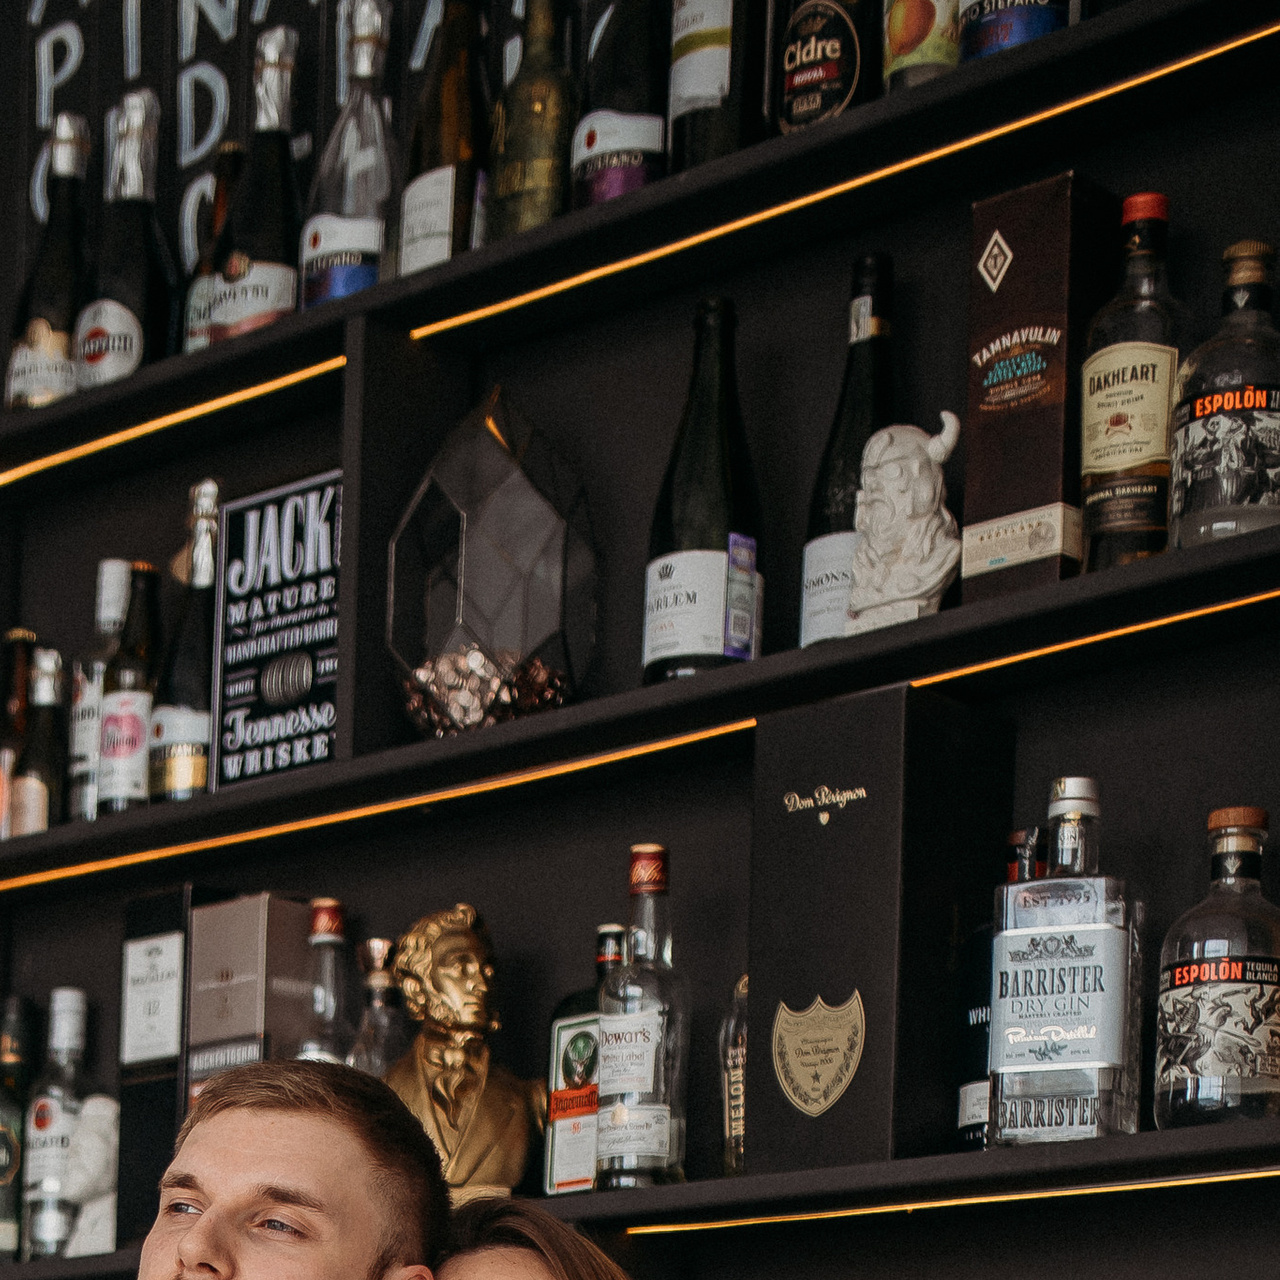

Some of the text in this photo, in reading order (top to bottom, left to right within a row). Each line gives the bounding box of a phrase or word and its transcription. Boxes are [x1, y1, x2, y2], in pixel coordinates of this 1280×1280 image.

[972, 326, 1062, 368] TAMNAVULIN
[1089, 363, 1158, 397] OAKHEART
[228, 486, 335, 597] JACK
[223, 733, 336, 781] WHISKE
[784, 792, 814, 812] Dom
[999, 965, 1105, 999] BARRISTER
[1246, 961, 1279, 974] TEQUILA
[1246, 972, 1279, 981] BLANCO
[1011, 996, 1091, 1014] DRY GIN
[730, 1068, 745, 1137] MELON
[999, 1097, 1102, 1128] BARRISTER
